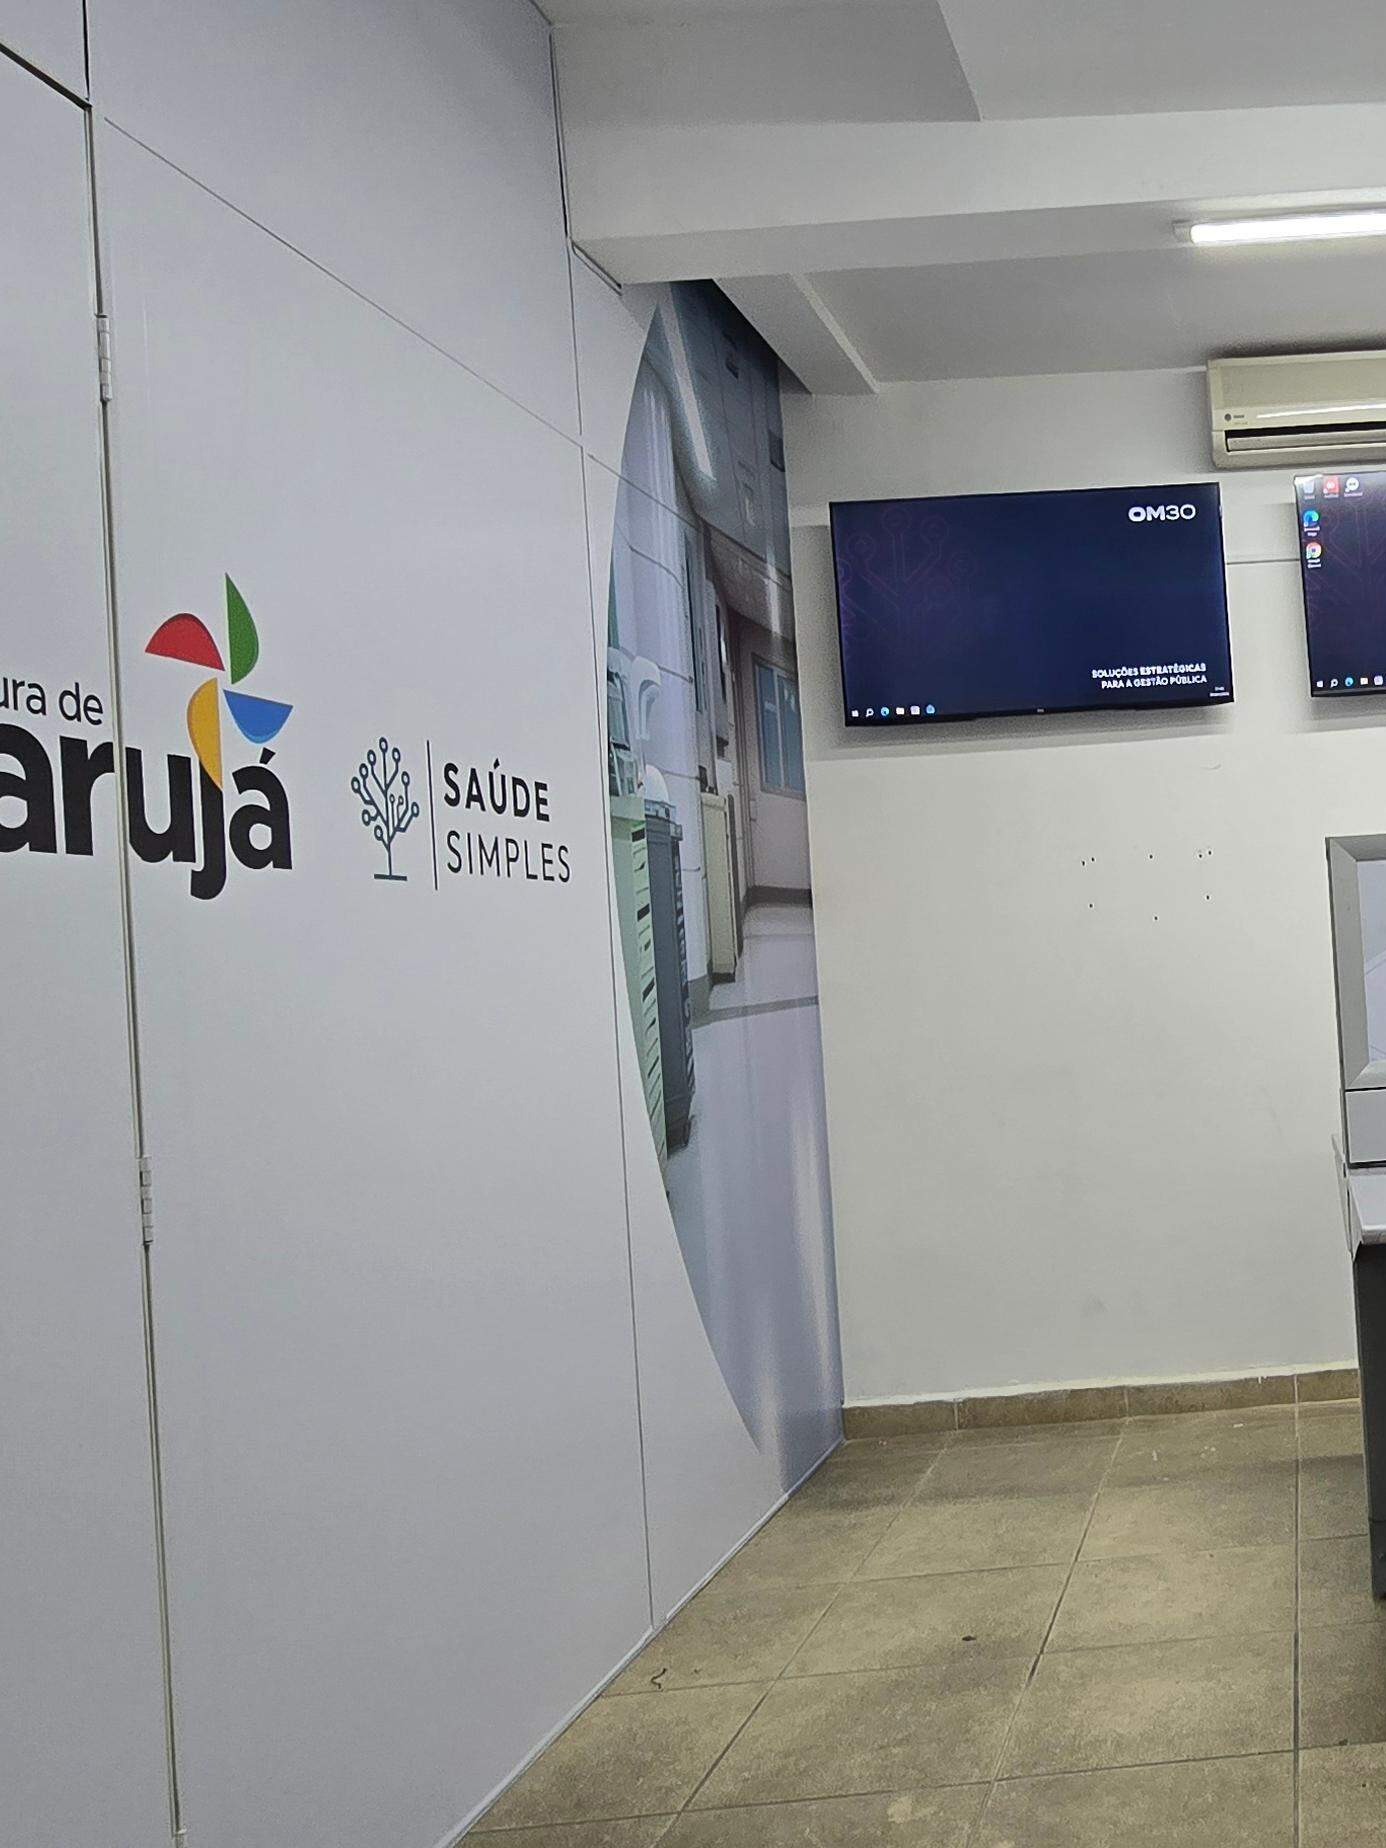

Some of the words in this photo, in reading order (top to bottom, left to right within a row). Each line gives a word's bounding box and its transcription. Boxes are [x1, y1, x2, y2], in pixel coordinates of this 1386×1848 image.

[1092, 666, 1138, 679] SOLUÇÕES
[1140, 662, 1207, 676] ESTRATÉGICAS
[1101, 679, 1125, 689] PARA
[1126, 679, 1133, 688] A
[1133, 676, 1168, 687] GESTÃO
[1169, 674, 1208, 685] PÚBLICA
[58, 681, 104, 726] de
[0, 722, 294, 901] arujá
[443, 757, 550, 822] SAÚDE
[447, 829, 570, 883] SIMPLES
